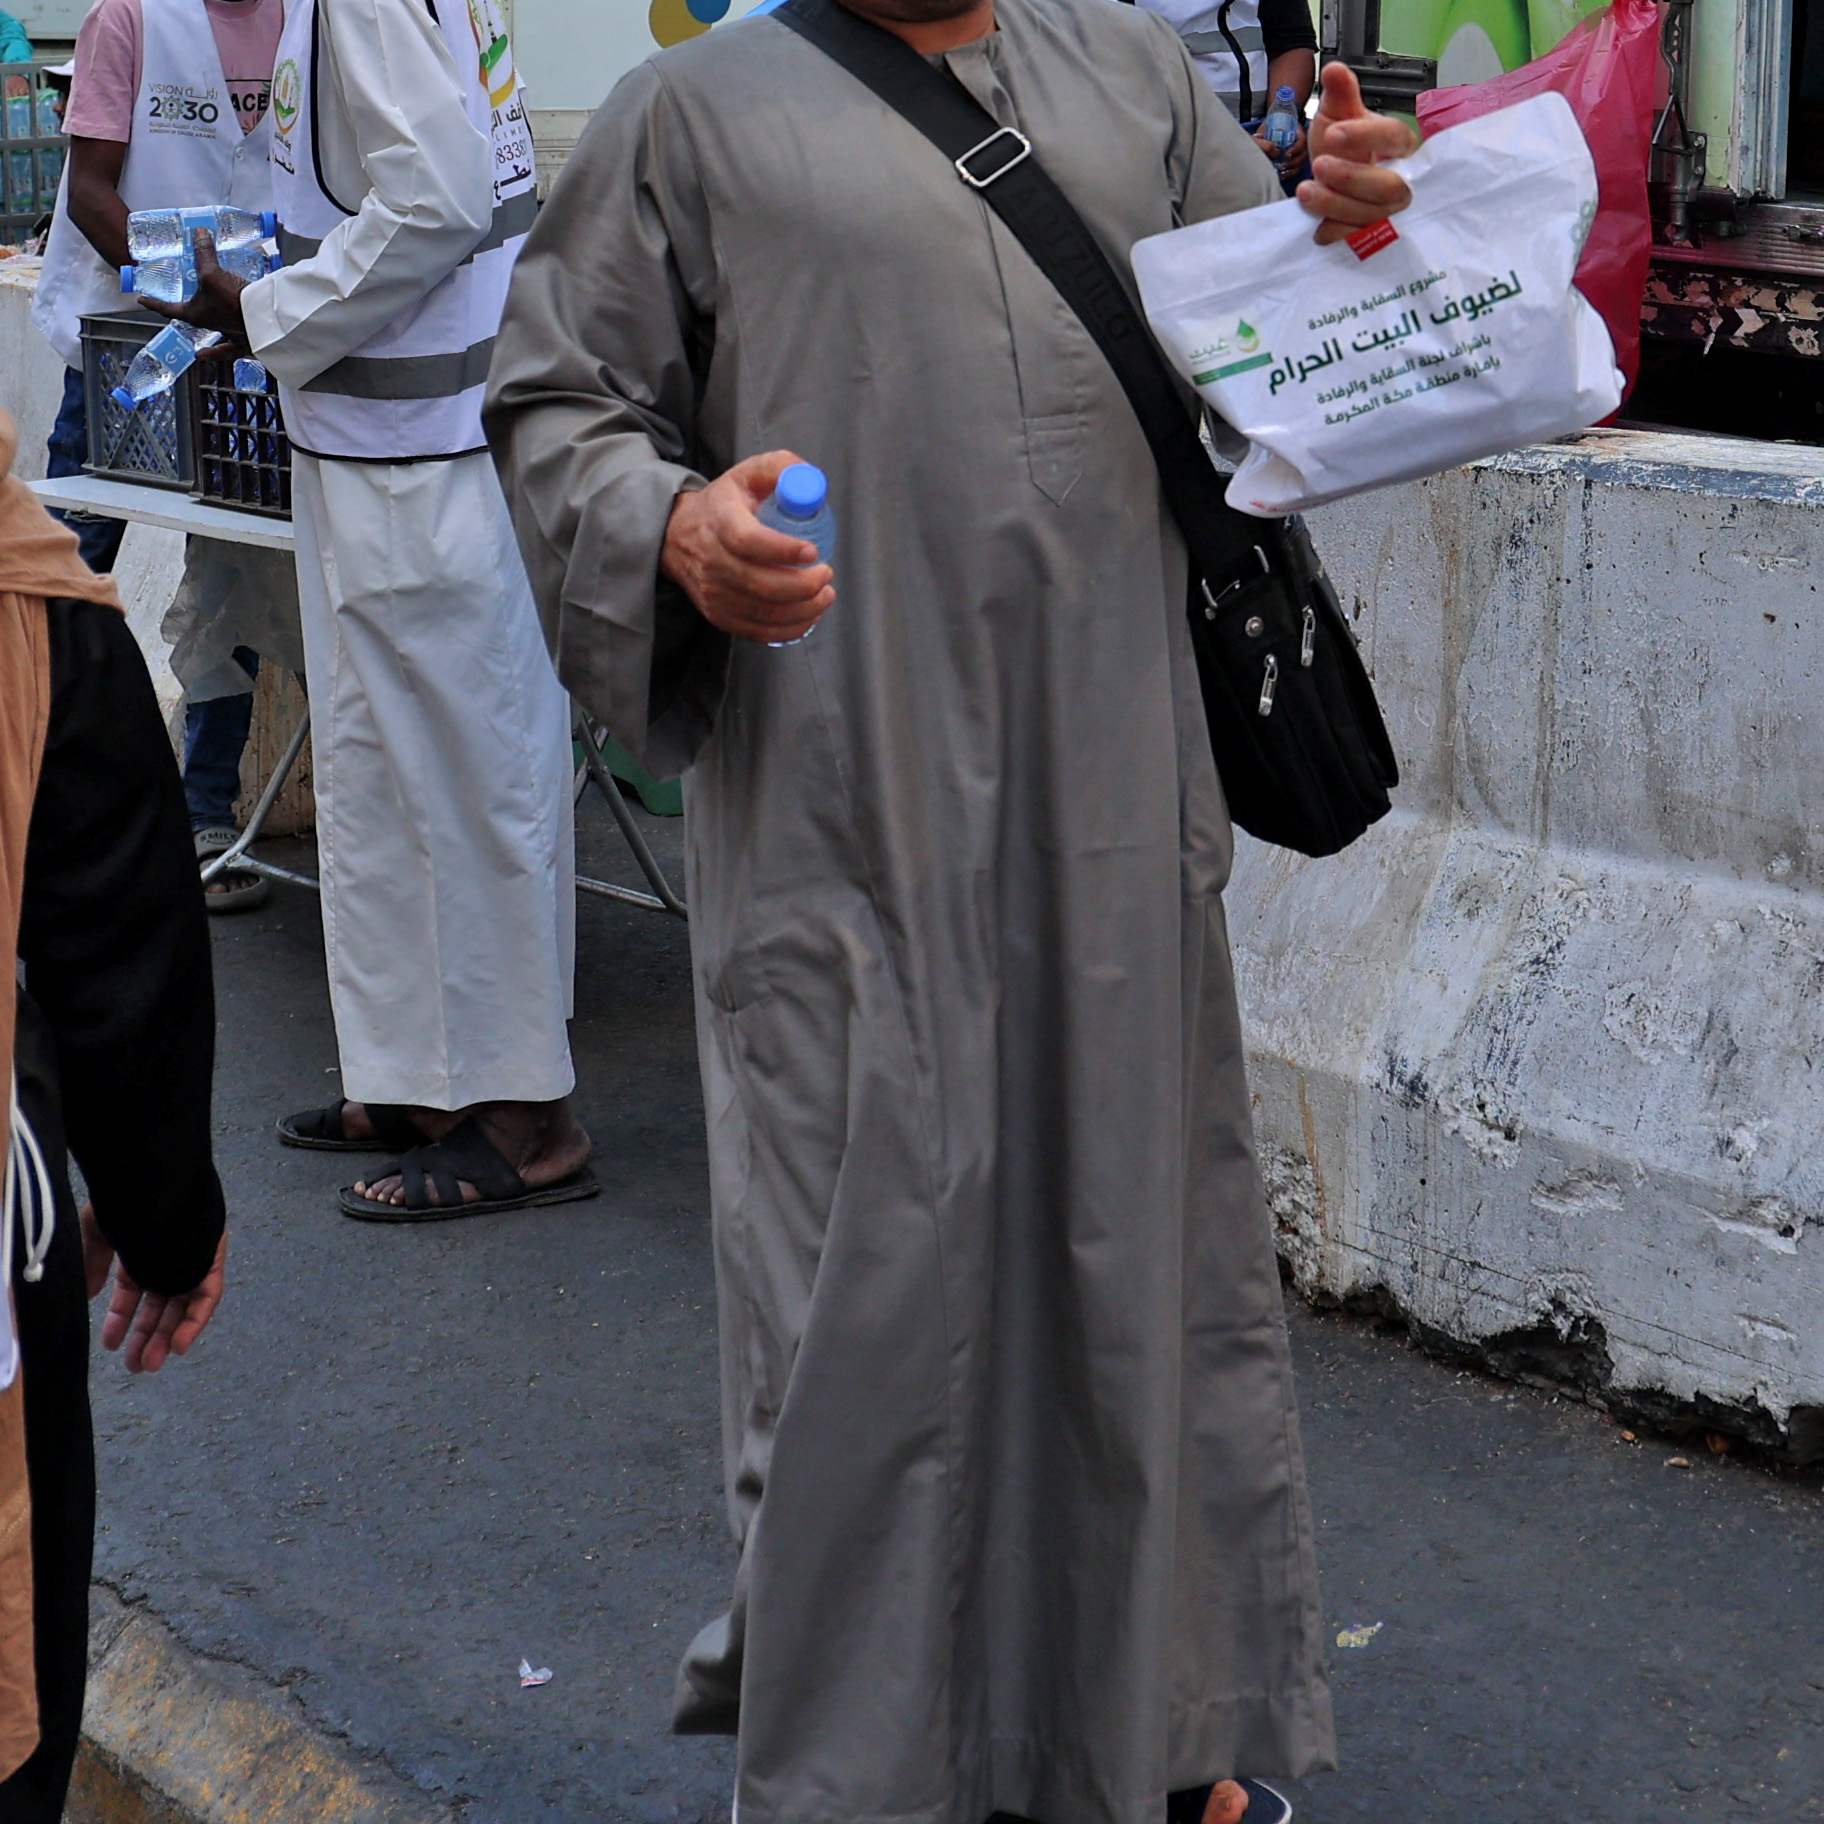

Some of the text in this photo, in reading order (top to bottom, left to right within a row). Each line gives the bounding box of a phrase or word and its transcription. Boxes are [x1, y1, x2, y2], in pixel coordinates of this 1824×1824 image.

[148, 83, 183, 98] VISION
[1308, 269, 1448, 331] مشروع السقاية والرفادة
[1267, 269, 1523, 395] لضيوف البيت الحرام
[1370, 358, 1416, 385] السقاية
[1416, 369, 1460, 394] منطقة
[1317, 378, 1367, 405] والرفادة
[1384, 385, 1413, 405] مكة
[1325, 398, 1380, 426] المكرمة
